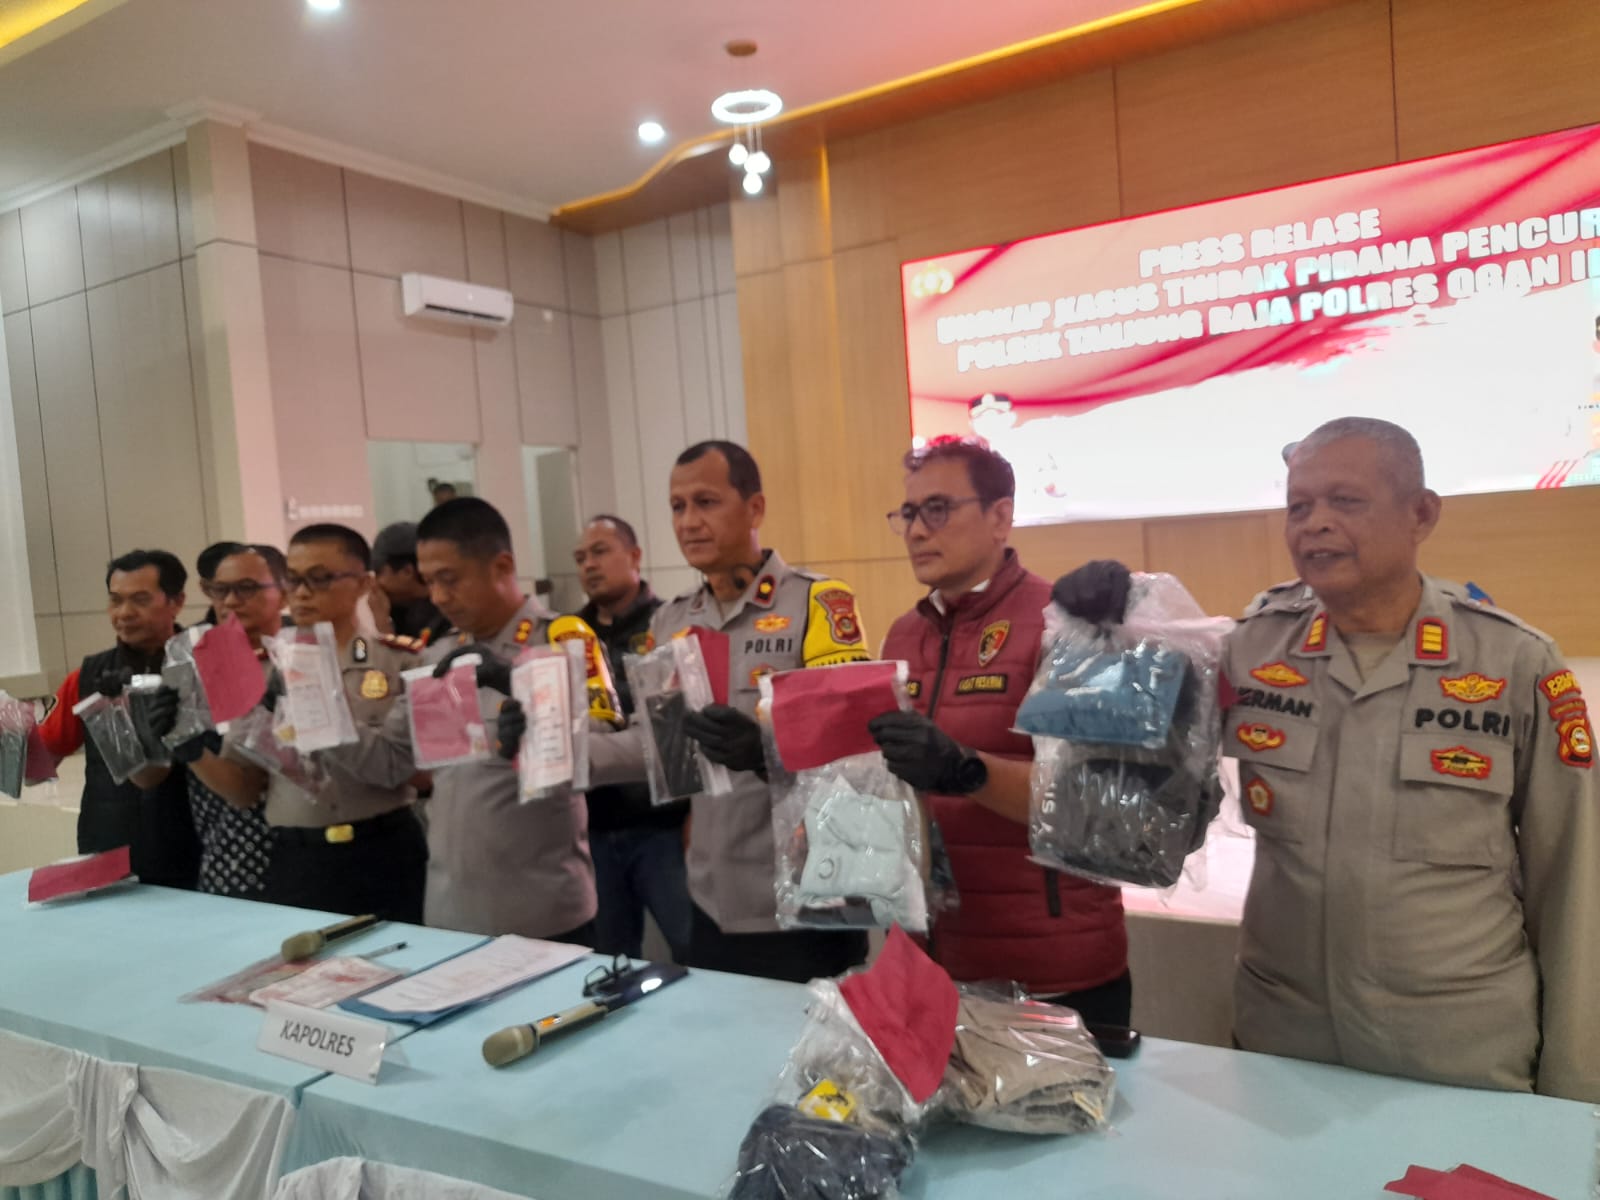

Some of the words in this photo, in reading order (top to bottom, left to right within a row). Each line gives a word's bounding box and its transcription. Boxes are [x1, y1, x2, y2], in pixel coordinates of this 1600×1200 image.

[1139, 233, 1245, 278] PRESS
[1053, 282, 1160, 328] KASUS
[1294, 236, 1436, 287] PIDANA
[1299, 272, 1440, 322] POLRES
[744, 637, 793, 654] POLRI
[1414, 708, 1511, 736] POLRI
[280, 1019, 356, 1057] KAPOLRES
